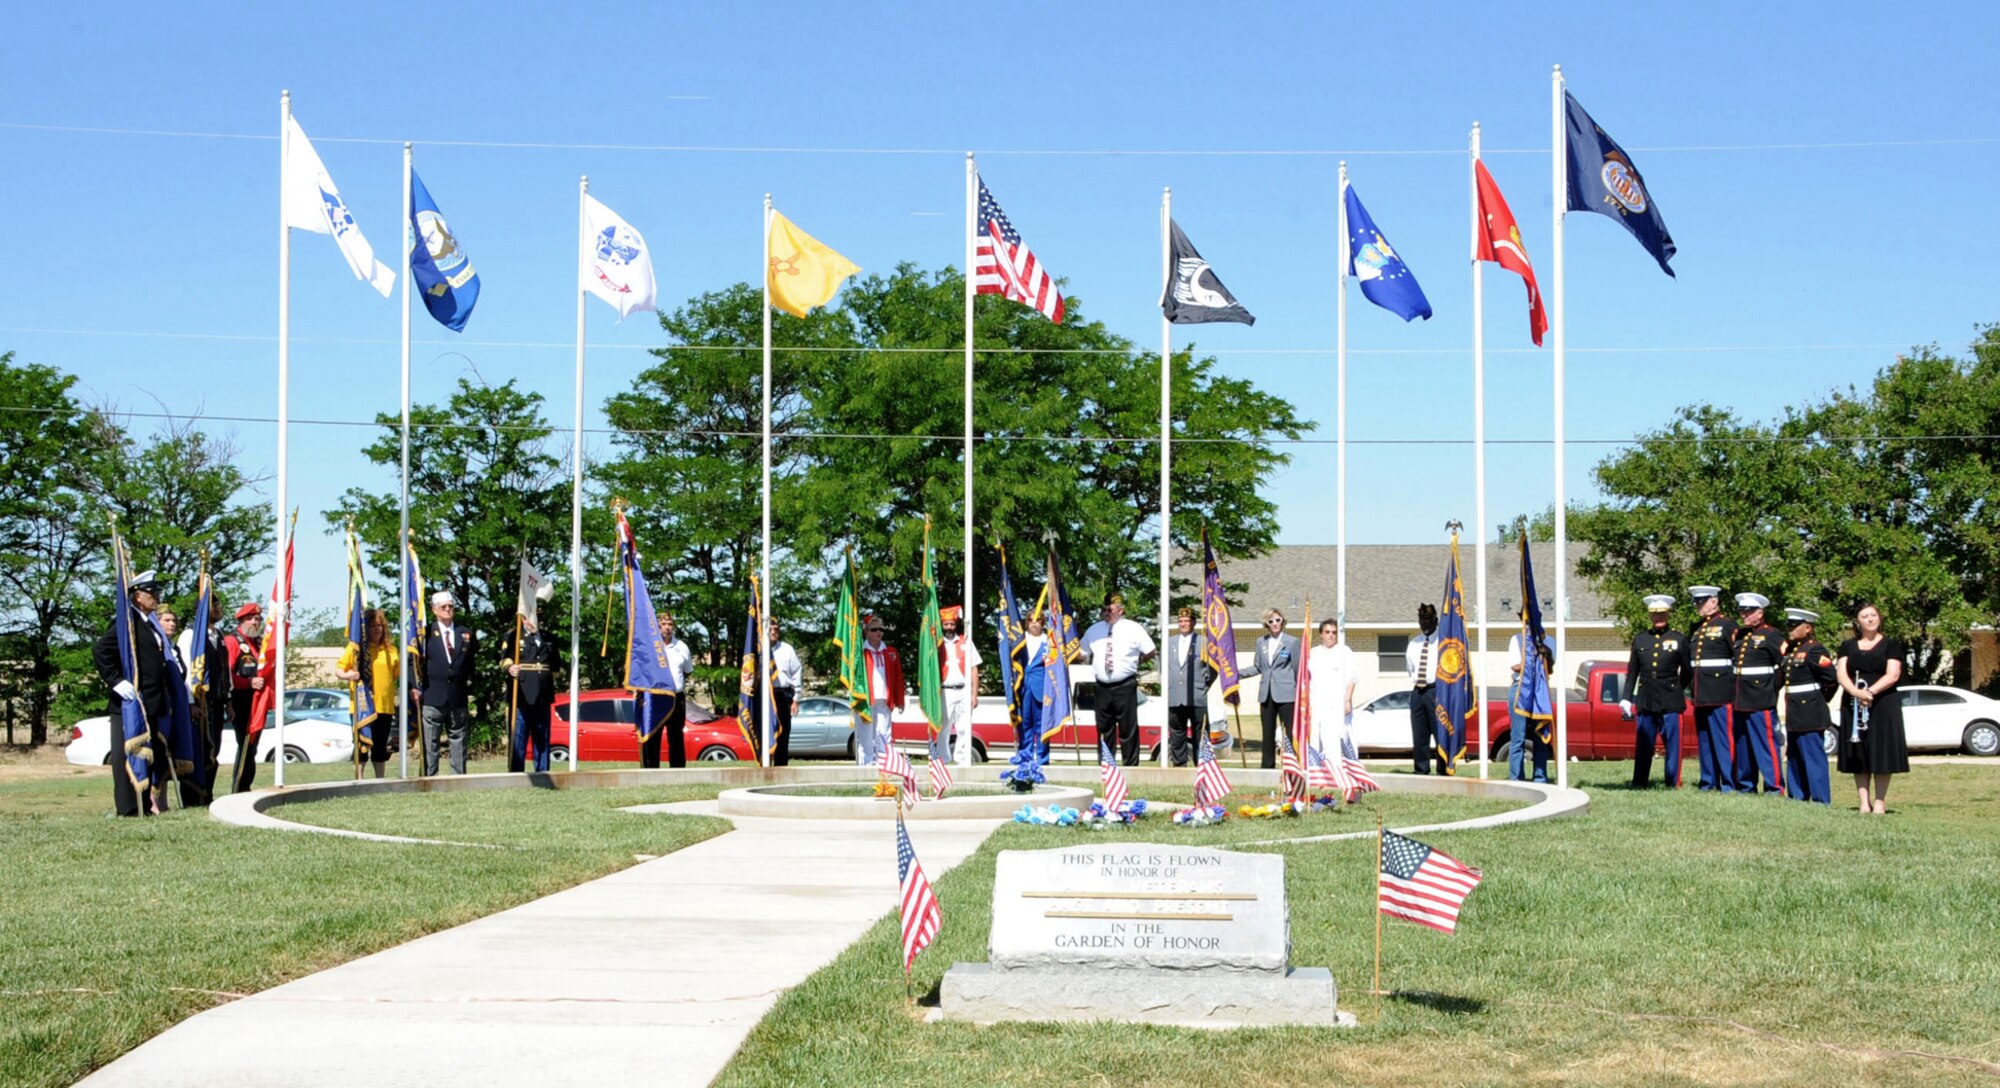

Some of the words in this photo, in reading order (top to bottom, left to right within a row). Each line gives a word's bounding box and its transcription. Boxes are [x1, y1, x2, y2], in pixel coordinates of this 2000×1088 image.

[1061, 854, 1094, 865] THIS
[1102, 854, 1141, 866] FLAG
[1148, 855, 1162, 866] IS
[1170, 855, 1222, 867] FLOWN
[1101, 866, 1113, 877] IN
[1118, 866, 1159, 878] HONOR
[1164, 867, 1178, 878] OF
[1111, 923, 1126, 934] IN
[1134, 923, 1164, 934] THE
[1055, 935, 1125, 948] GARDEN
[1133, 936, 1155, 949] OF
[1163, 936, 1221, 950] HONOR
